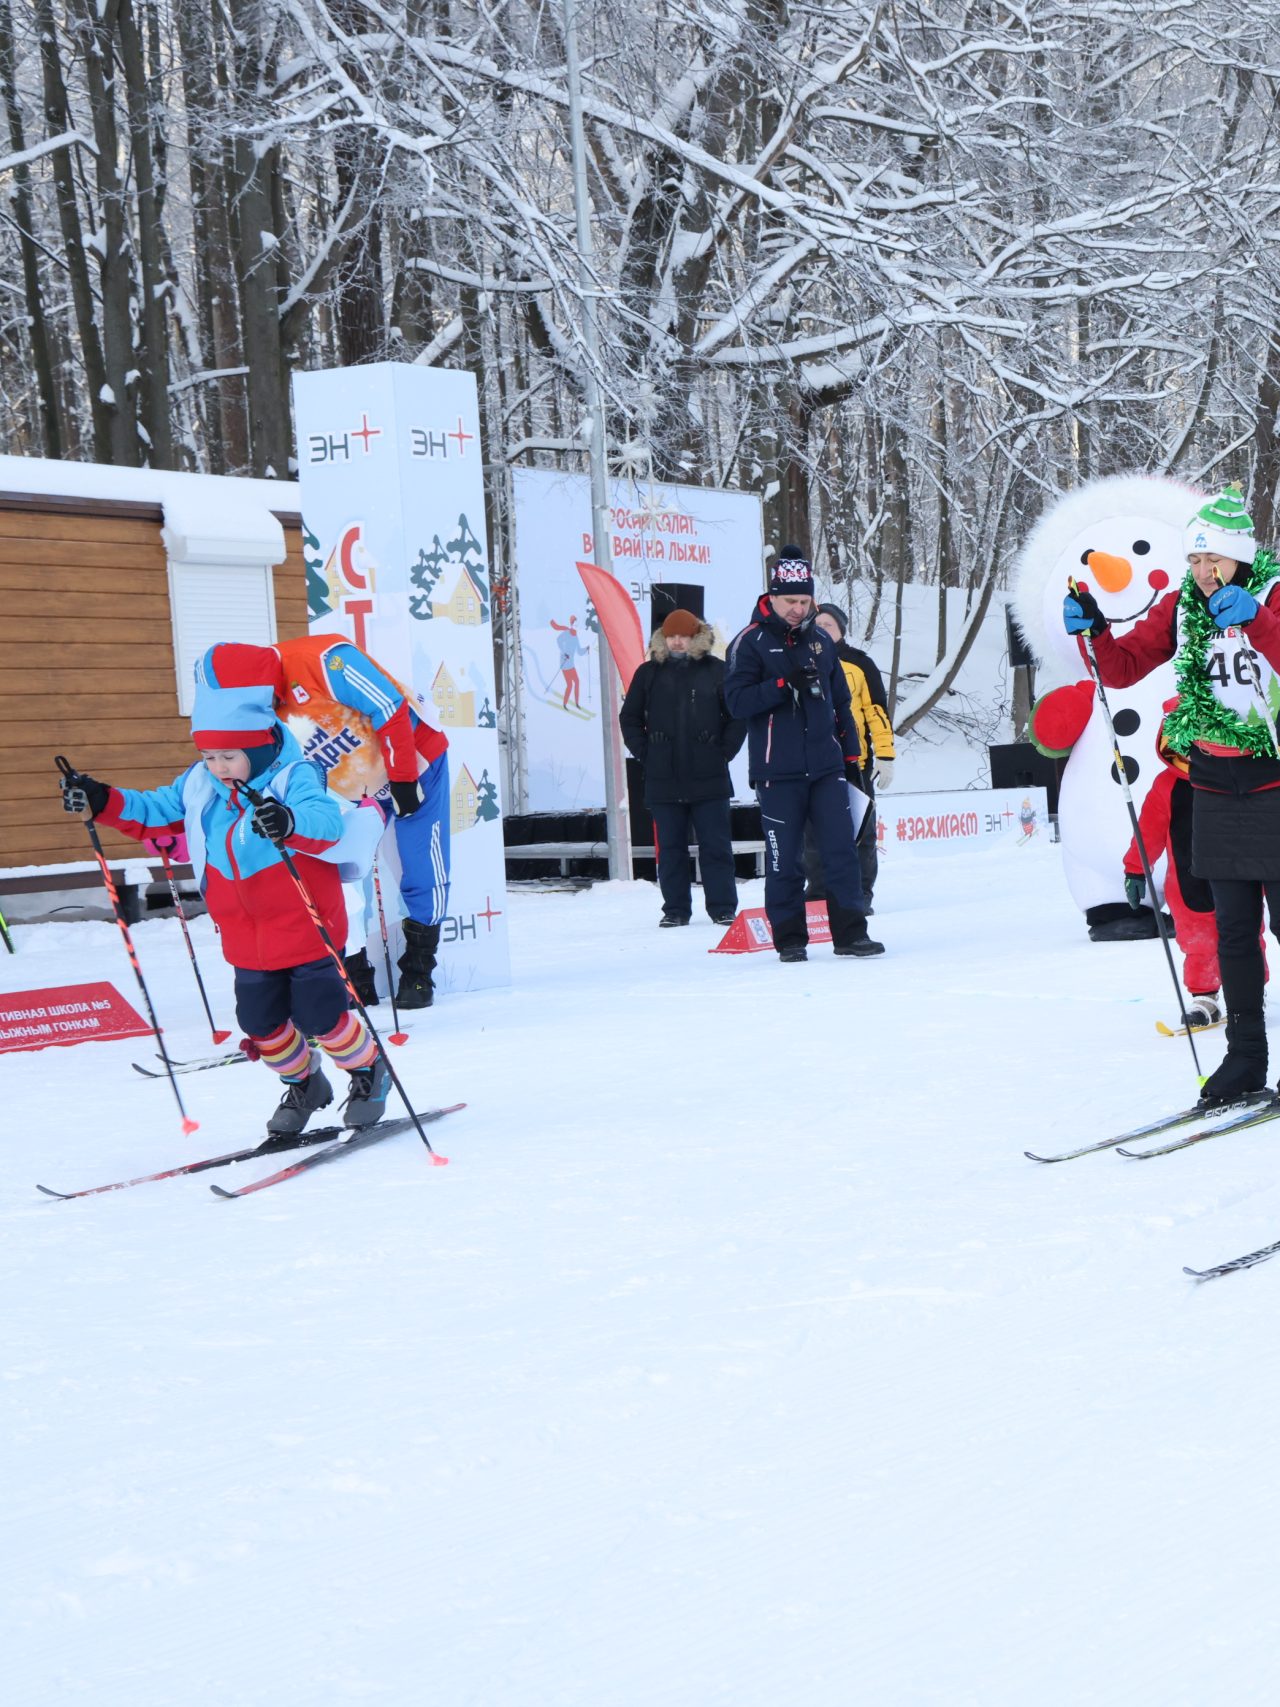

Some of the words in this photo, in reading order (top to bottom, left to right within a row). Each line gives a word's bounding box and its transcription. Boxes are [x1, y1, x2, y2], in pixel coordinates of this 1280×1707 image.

[646, 540, 665, 559] НА
[669, 541, 712, 564] ЛЫЖИ!
[896, 812, 979, 842] #ЗАЖИГАЕМ
[768, 829, 780, 872] RUSSIA
[48, 1002, 91, 1016] ШКОЛА
[91, 999, 112, 1010] №5
[53, 1017, 101, 1033] ГОНКАМ
